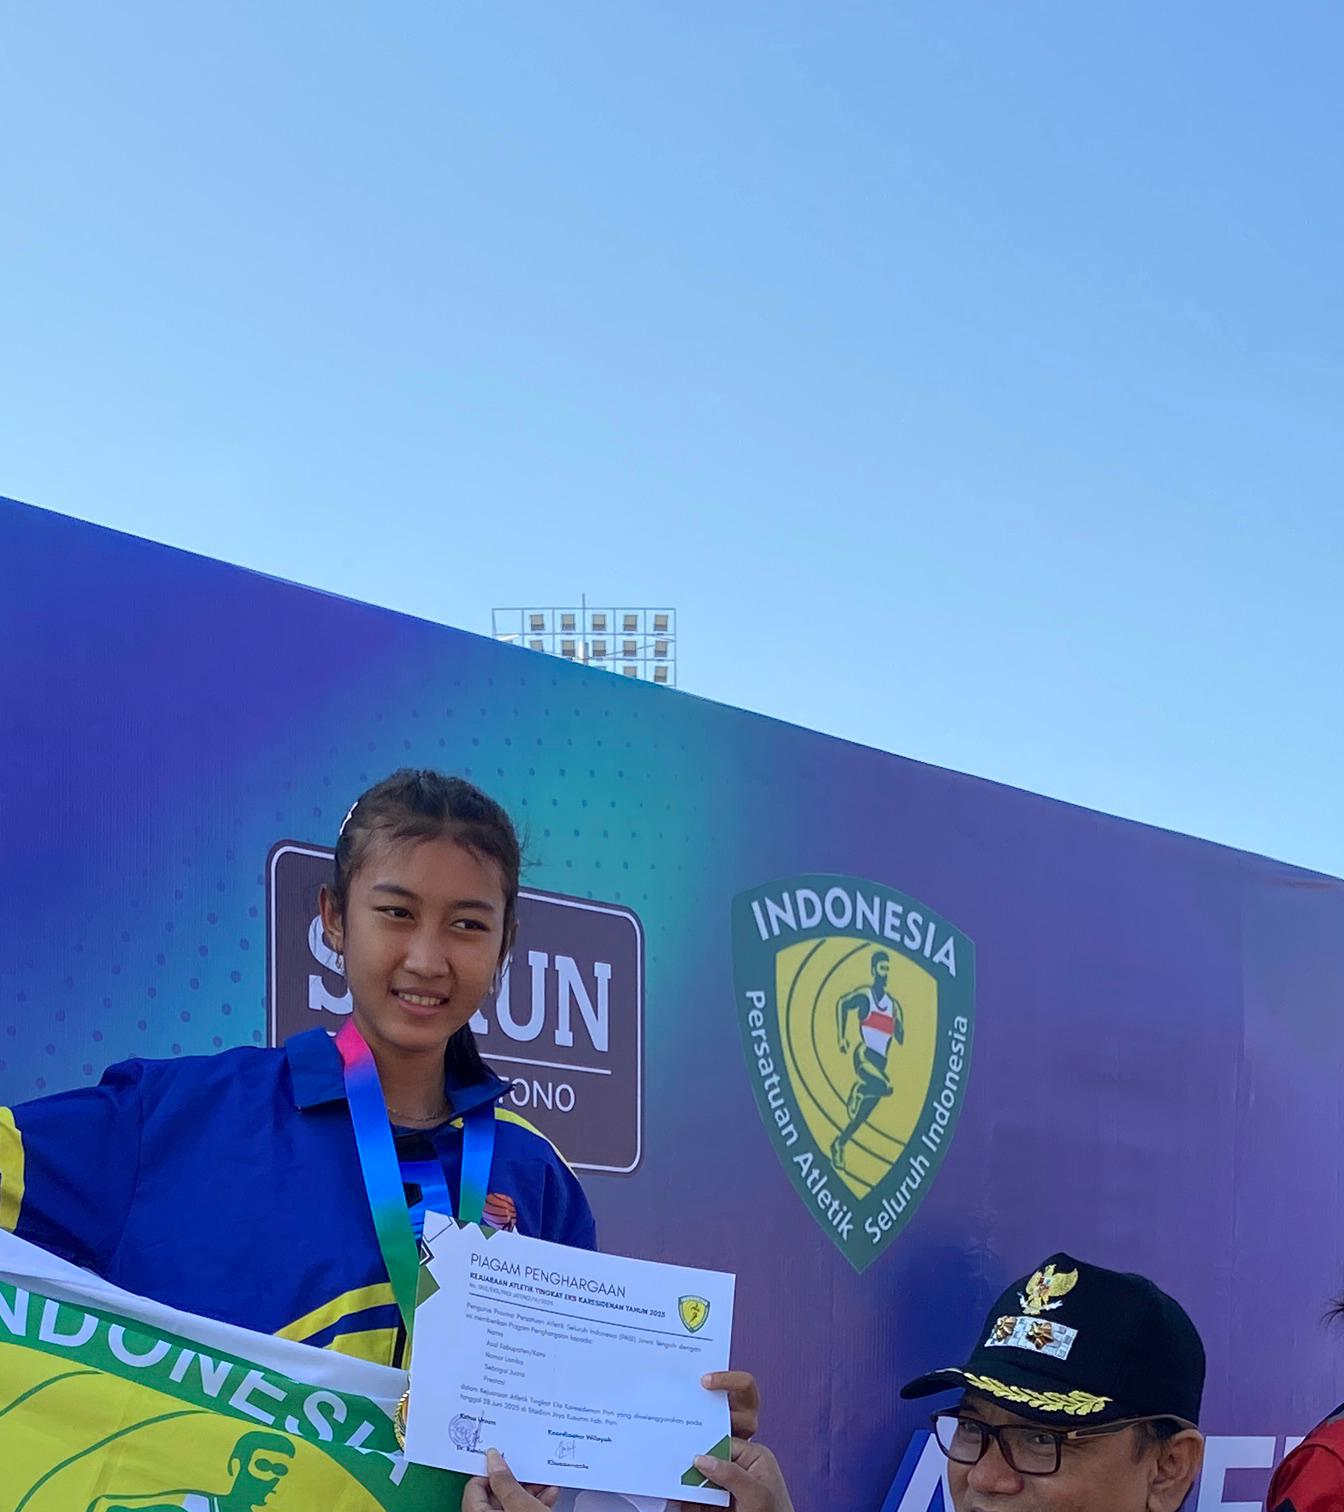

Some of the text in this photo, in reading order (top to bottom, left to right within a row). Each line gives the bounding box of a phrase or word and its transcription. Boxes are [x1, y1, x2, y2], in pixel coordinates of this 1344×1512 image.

[308, 914, 611, 1052] SUN
[751, 887, 959, 977] INDONESIA
[744, 989, 855, 1243] Persatuan Atletik
[863, 1014, 970, 1245] Seluruh Indonesia
[470, 1253, 521, 1277] PIAGAM
[524, 1266, 627, 1298] PENGHARGAAN
[509, 1281, 534, 1293] ATLETIK
[535, 1287, 564, 1299] TINGKAT
[564, 1293, 577, 1302] EKS
[625, 1305, 649, 1315] TAHUN
